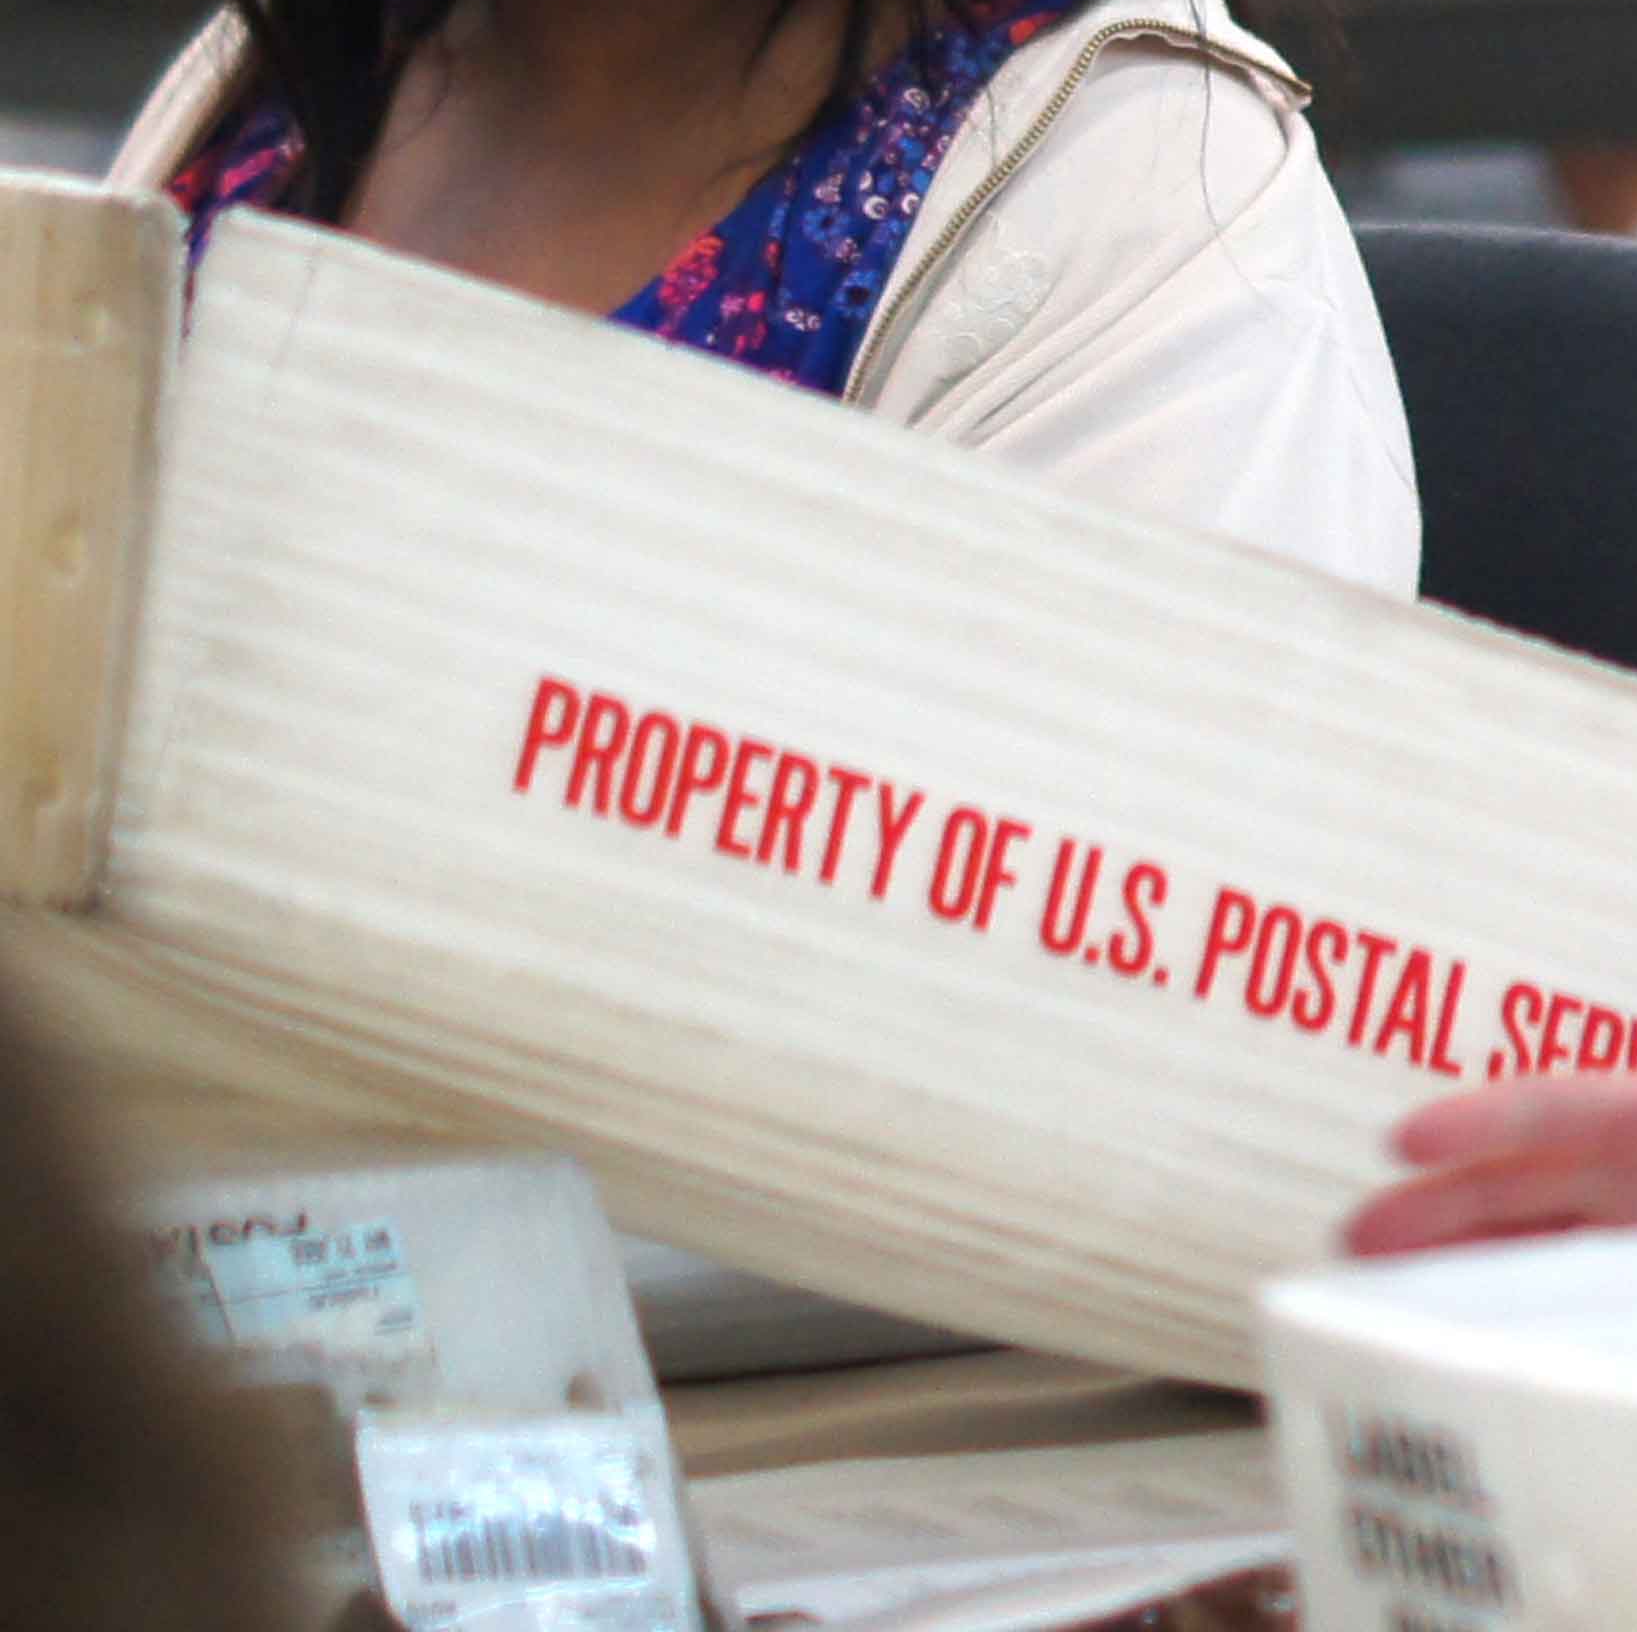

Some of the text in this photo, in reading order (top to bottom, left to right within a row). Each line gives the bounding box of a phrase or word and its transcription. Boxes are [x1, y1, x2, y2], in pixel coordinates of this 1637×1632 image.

[511, 675, 925, 901] PROPERTY
[926, 804, 1034, 933] OF
[1038, 835, 1171, 988] U.S.
[1192, 885, 1468, 1080] POSTAL
